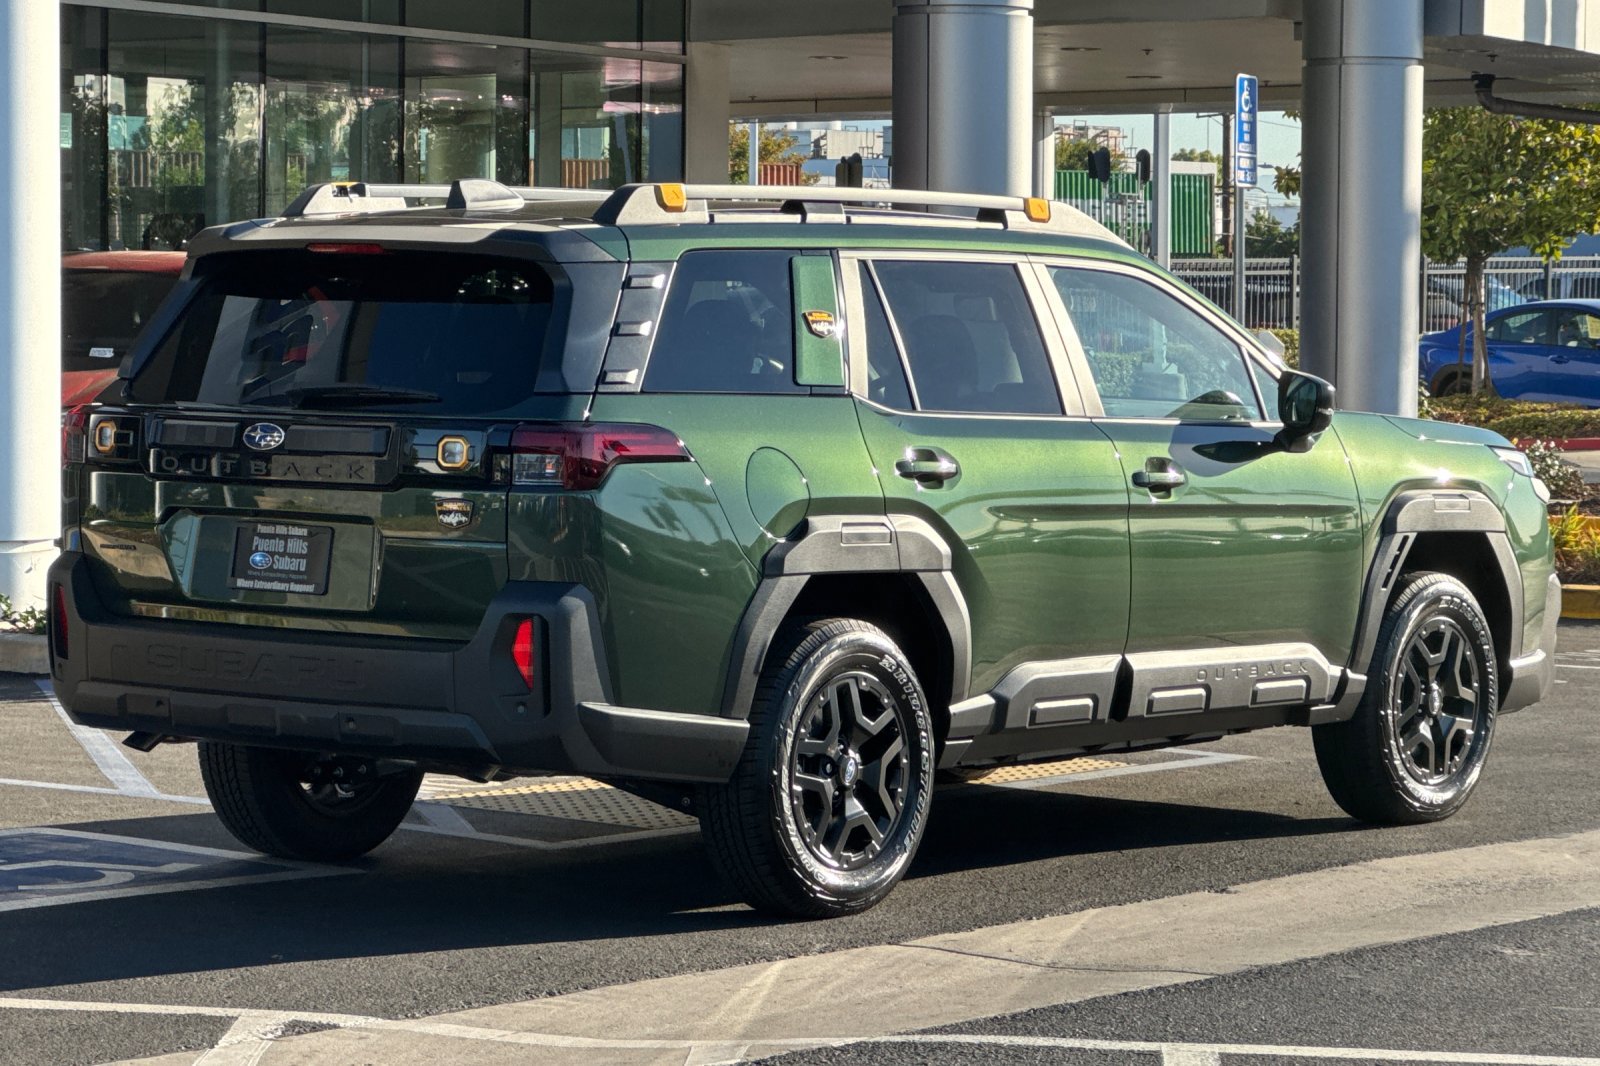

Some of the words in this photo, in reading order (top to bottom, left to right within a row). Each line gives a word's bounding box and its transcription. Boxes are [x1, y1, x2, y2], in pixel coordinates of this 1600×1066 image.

[161, 454, 366, 480] OUTBACK
[252, 535, 285, 553] Puente
[286, 538, 308, 554] Hills
[273, 554, 307, 571] Subaru
[147, 644, 368, 690] SUBARU
[1196, 660, 1308, 682] OUTBACK
